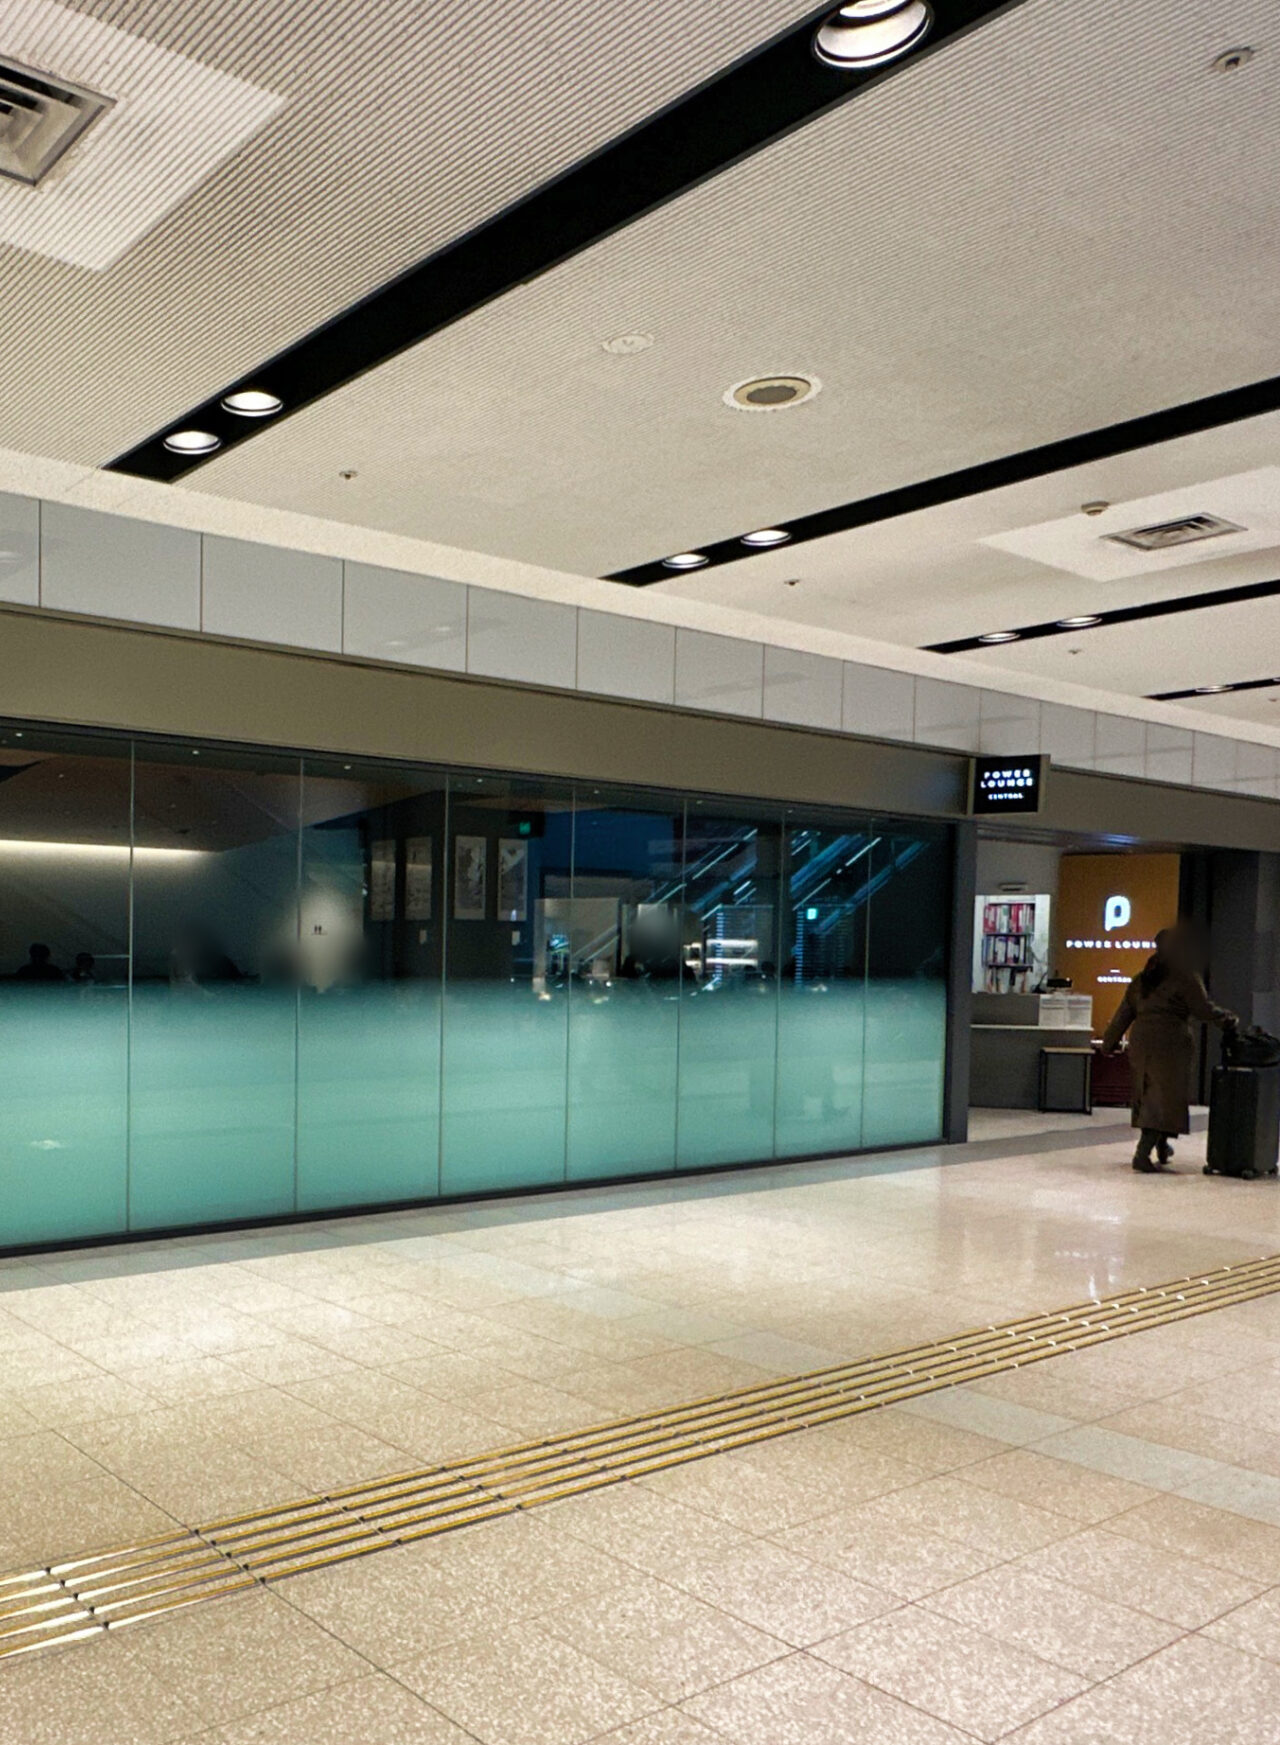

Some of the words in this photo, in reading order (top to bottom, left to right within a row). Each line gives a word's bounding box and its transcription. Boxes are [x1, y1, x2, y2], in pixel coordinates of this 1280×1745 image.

[984, 768, 1031, 779] POWER
[980, 778, 1033, 788] LOUNGE
[1066, 940, 1112, 948] POWER
